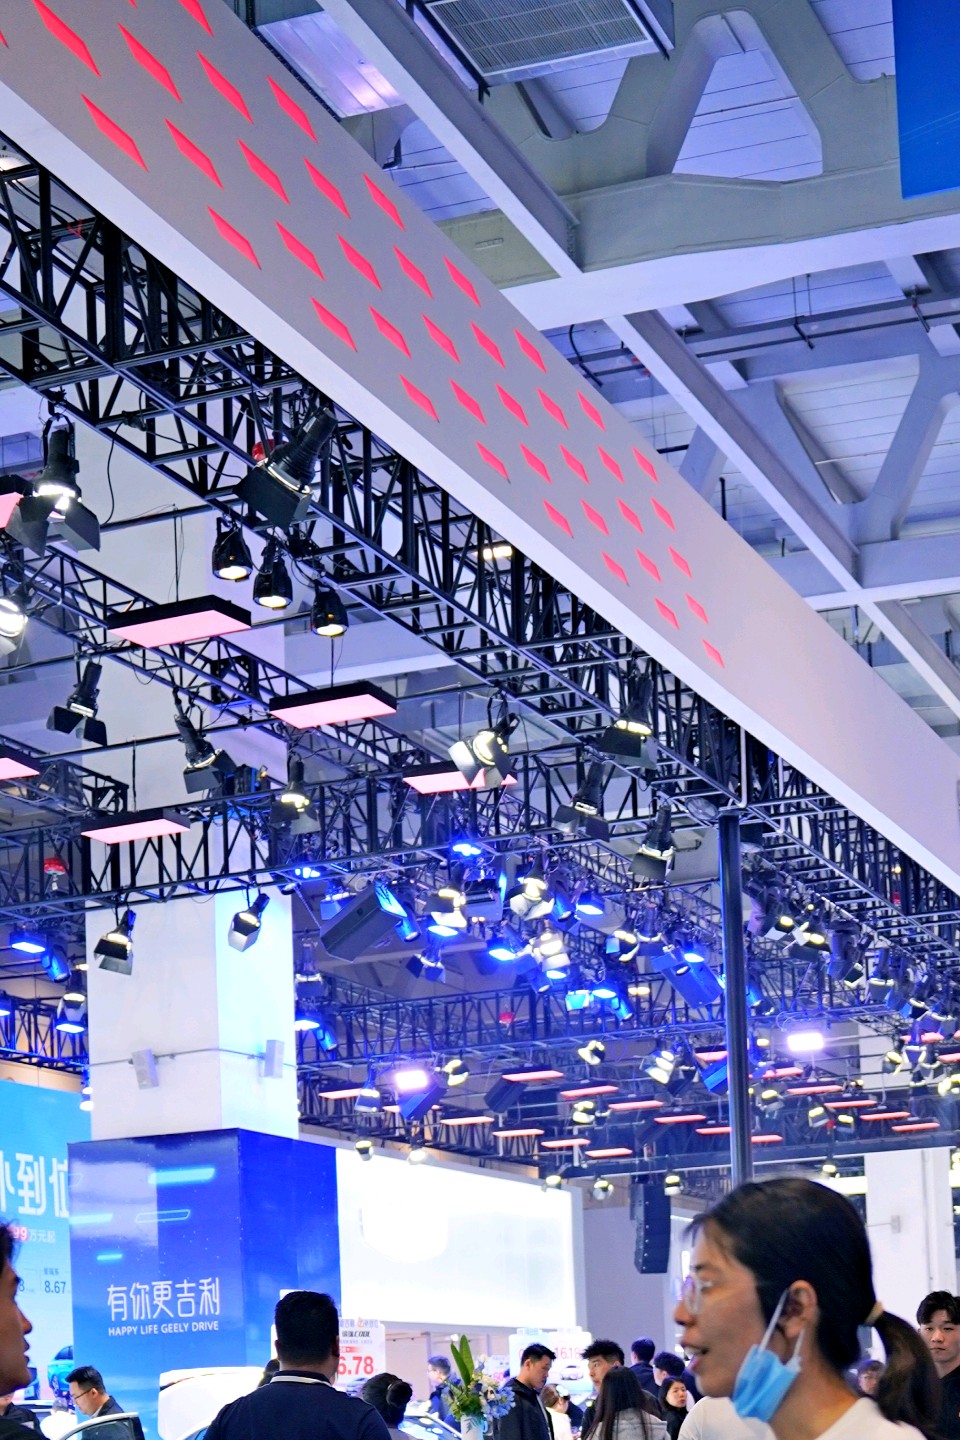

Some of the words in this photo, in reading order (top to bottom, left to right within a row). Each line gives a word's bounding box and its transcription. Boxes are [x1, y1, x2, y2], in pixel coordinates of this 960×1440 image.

[44, 1280, 66, 1294] 8.67
[107, 1277, 220, 1321] 有你更吉利
[108, 1325, 138, 1336] HAPPY
[140, 1324, 159, 1335] LIFE
[161, 1322, 189, 1333] GEELY
[192, 1320, 219, 1332] DRIVE
